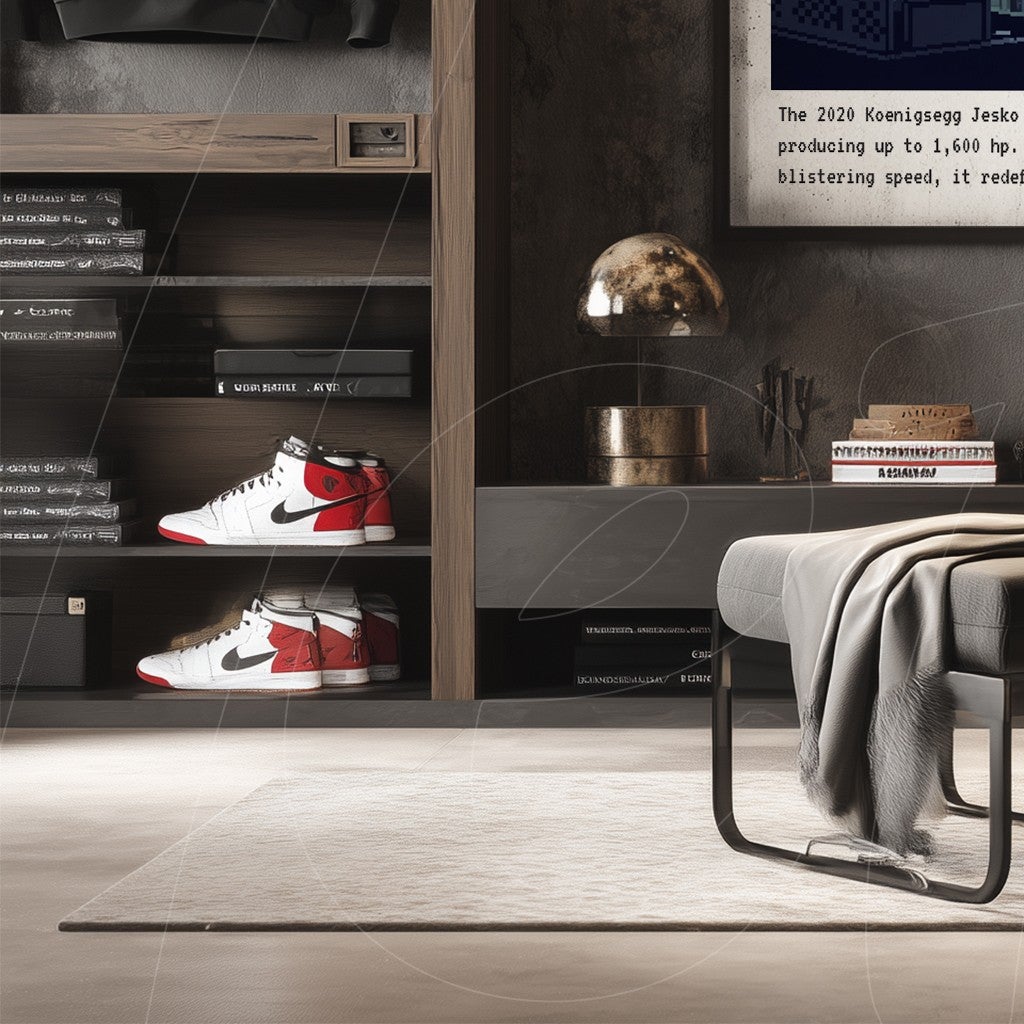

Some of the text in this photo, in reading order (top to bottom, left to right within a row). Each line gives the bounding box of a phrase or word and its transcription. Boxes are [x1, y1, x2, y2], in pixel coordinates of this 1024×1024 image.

[779, 107, 807, 122] The
[817, 107, 855, 122] 2020
[865, 107, 962, 126] Koenigsegg
[971, 107, 1019, 123] Jesko
[778, 138, 865, 157] producing
[875, 142, 894, 157] up
[903, 138, 923, 153] to
[933, 138, 980, 157] 1,600
[990, 138, 1018, 157] hp.
[778, 169, 875, 188] blistering
[885, 169, 941, 188] speed,
[953, 169, 970, 184] it
